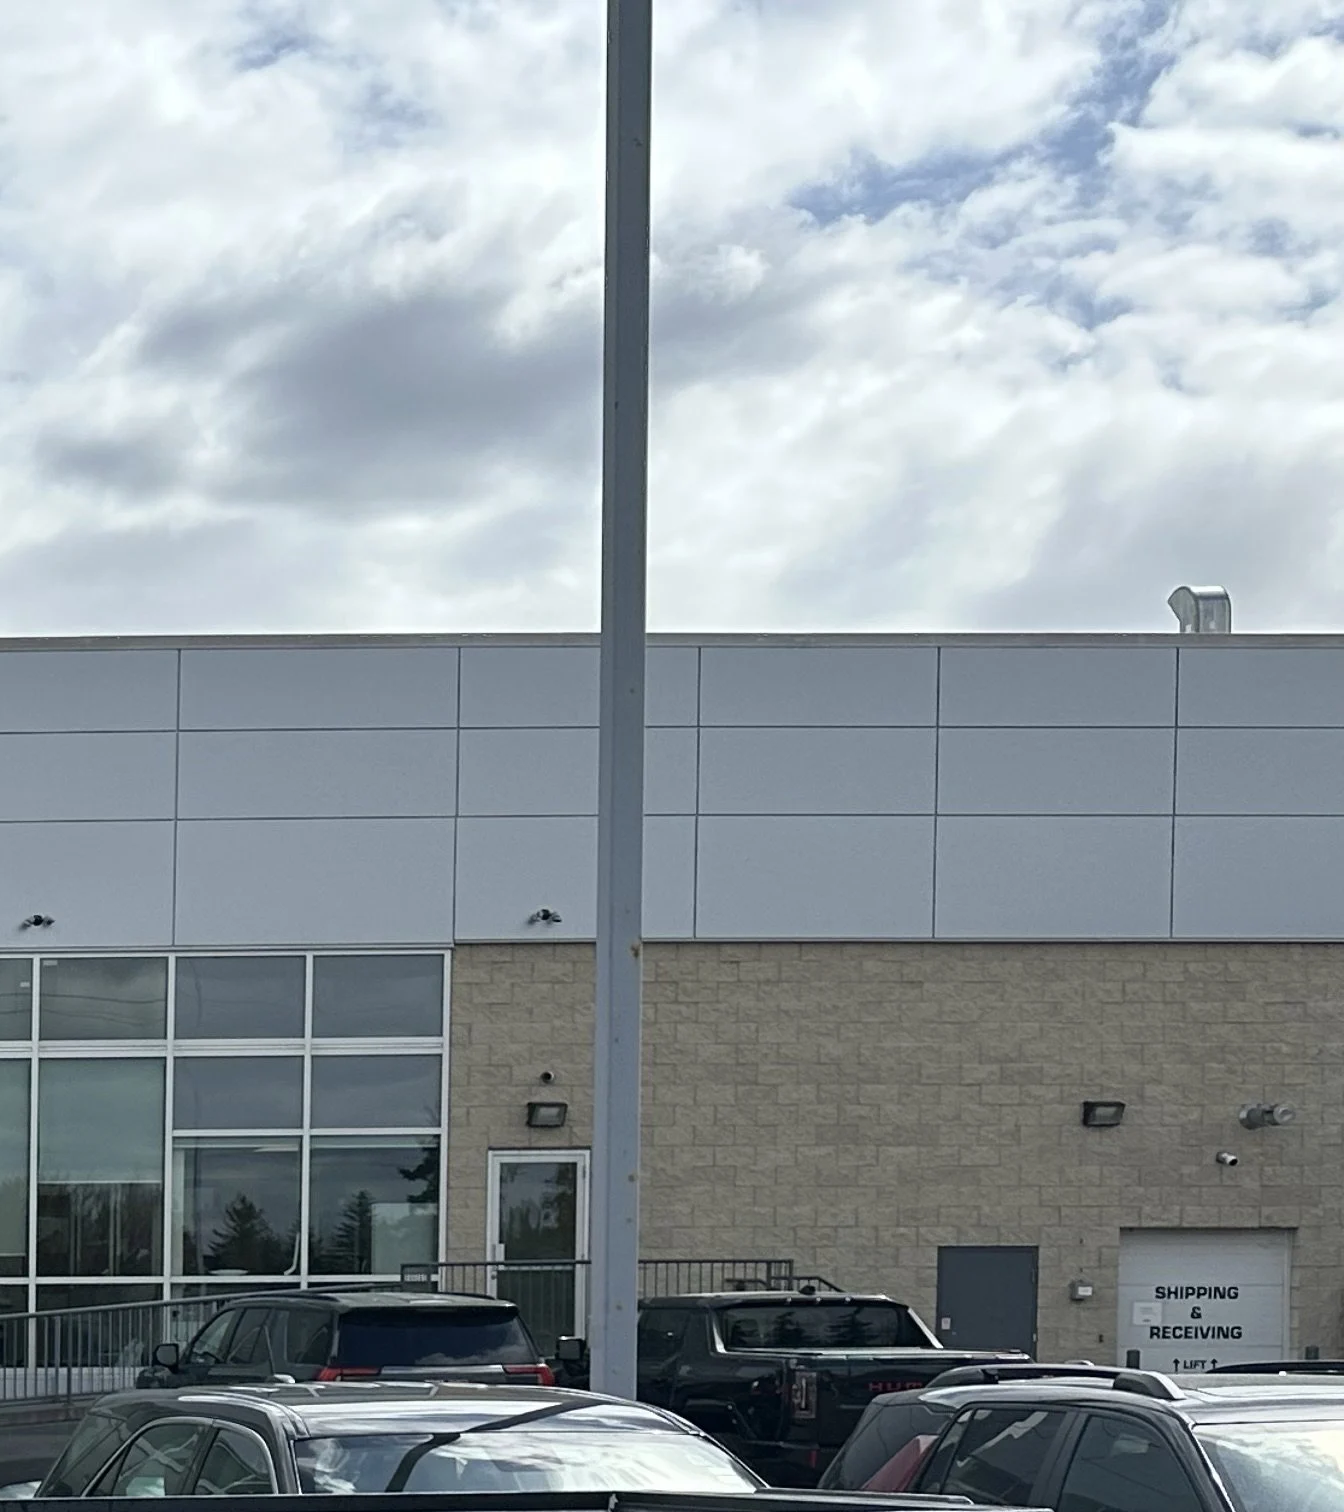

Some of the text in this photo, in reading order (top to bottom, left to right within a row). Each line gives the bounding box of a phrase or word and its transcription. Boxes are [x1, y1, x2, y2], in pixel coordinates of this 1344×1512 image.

[1155, 1286, 1239, 1300] SHIPPING
[1190, 1306, 1202, 1319] &
[1149, 1326, 1243, 1339] RECEIVING
[1183, 1360, 1207, 1370] LIFT
